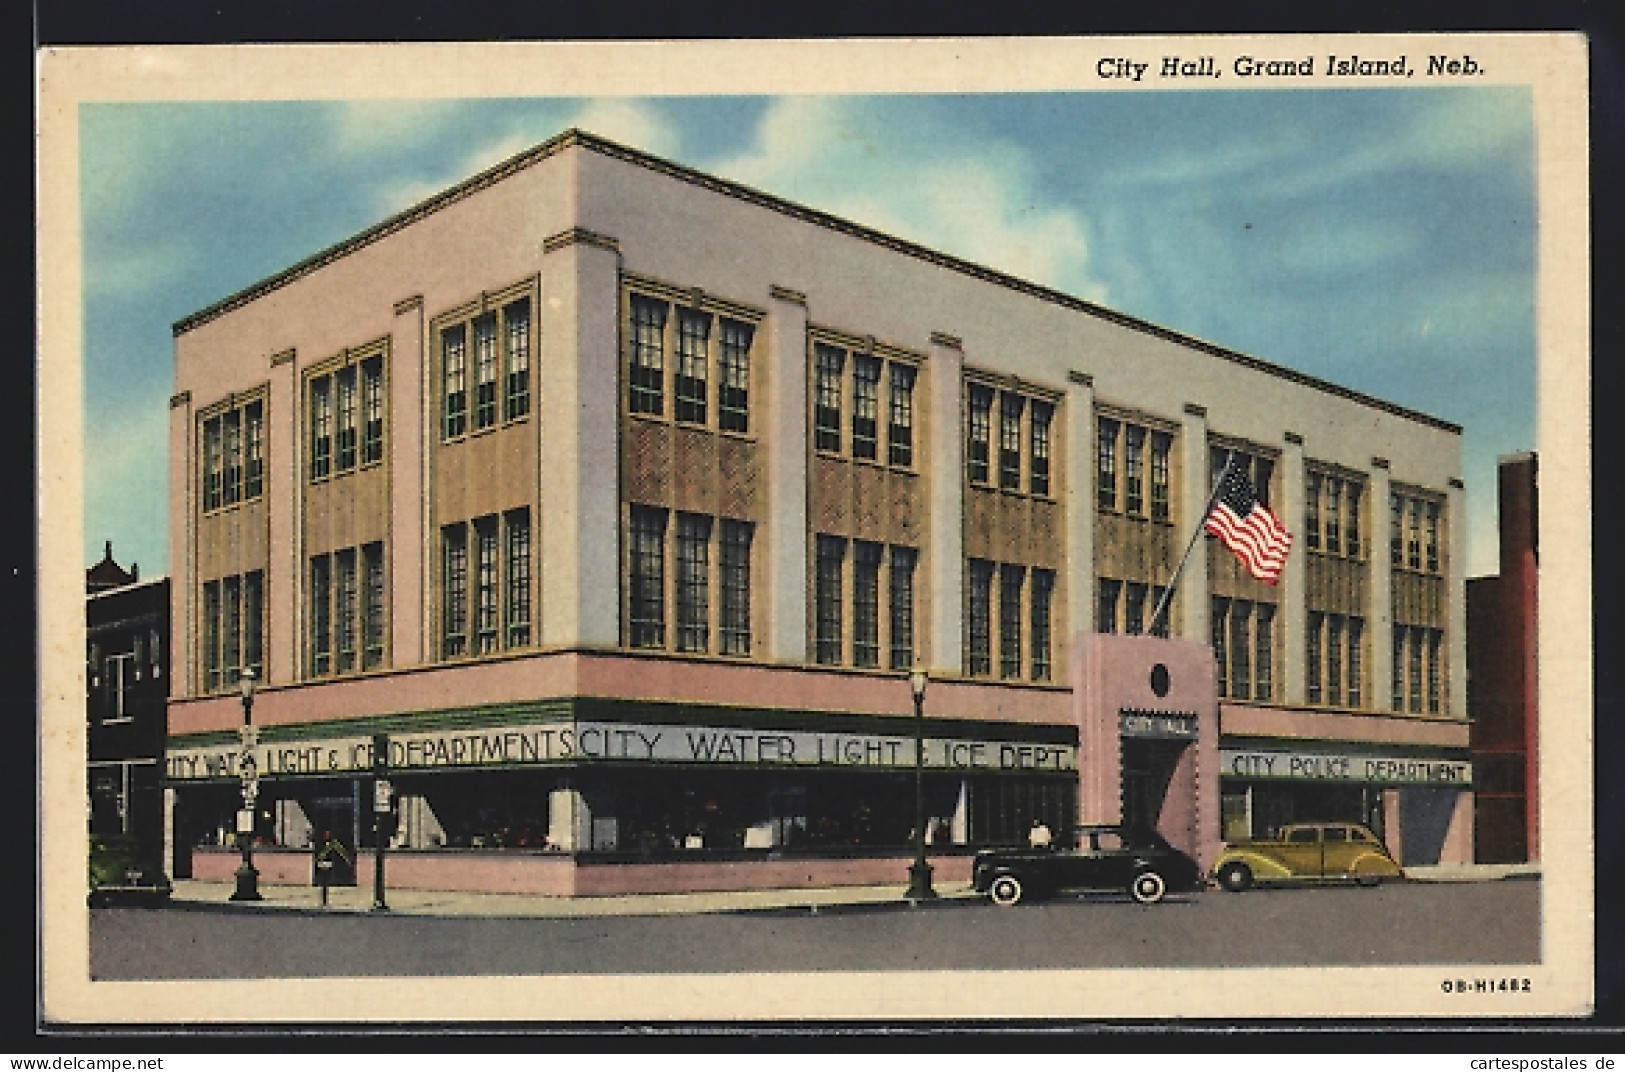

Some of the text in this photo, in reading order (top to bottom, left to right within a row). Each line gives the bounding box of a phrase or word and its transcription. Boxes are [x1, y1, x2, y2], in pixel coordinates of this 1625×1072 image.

[1096, 55, 1485, 81] City Hall, Grand Island, Neb.
[166, 754, 199, 777] ITY
[266, 746, 323, 772] LIGHT
[388, 729, 574, 768] DEPARTMENTS
[579, 727, 662, 759] CITY
[686, 732, 796, 762] WATER
[818, 737, 903, 765] LIGHT
[944, 741, 985, 768] ICE
[1231, 755, 1467, 782] CITY POLICE DEPARTMENT
